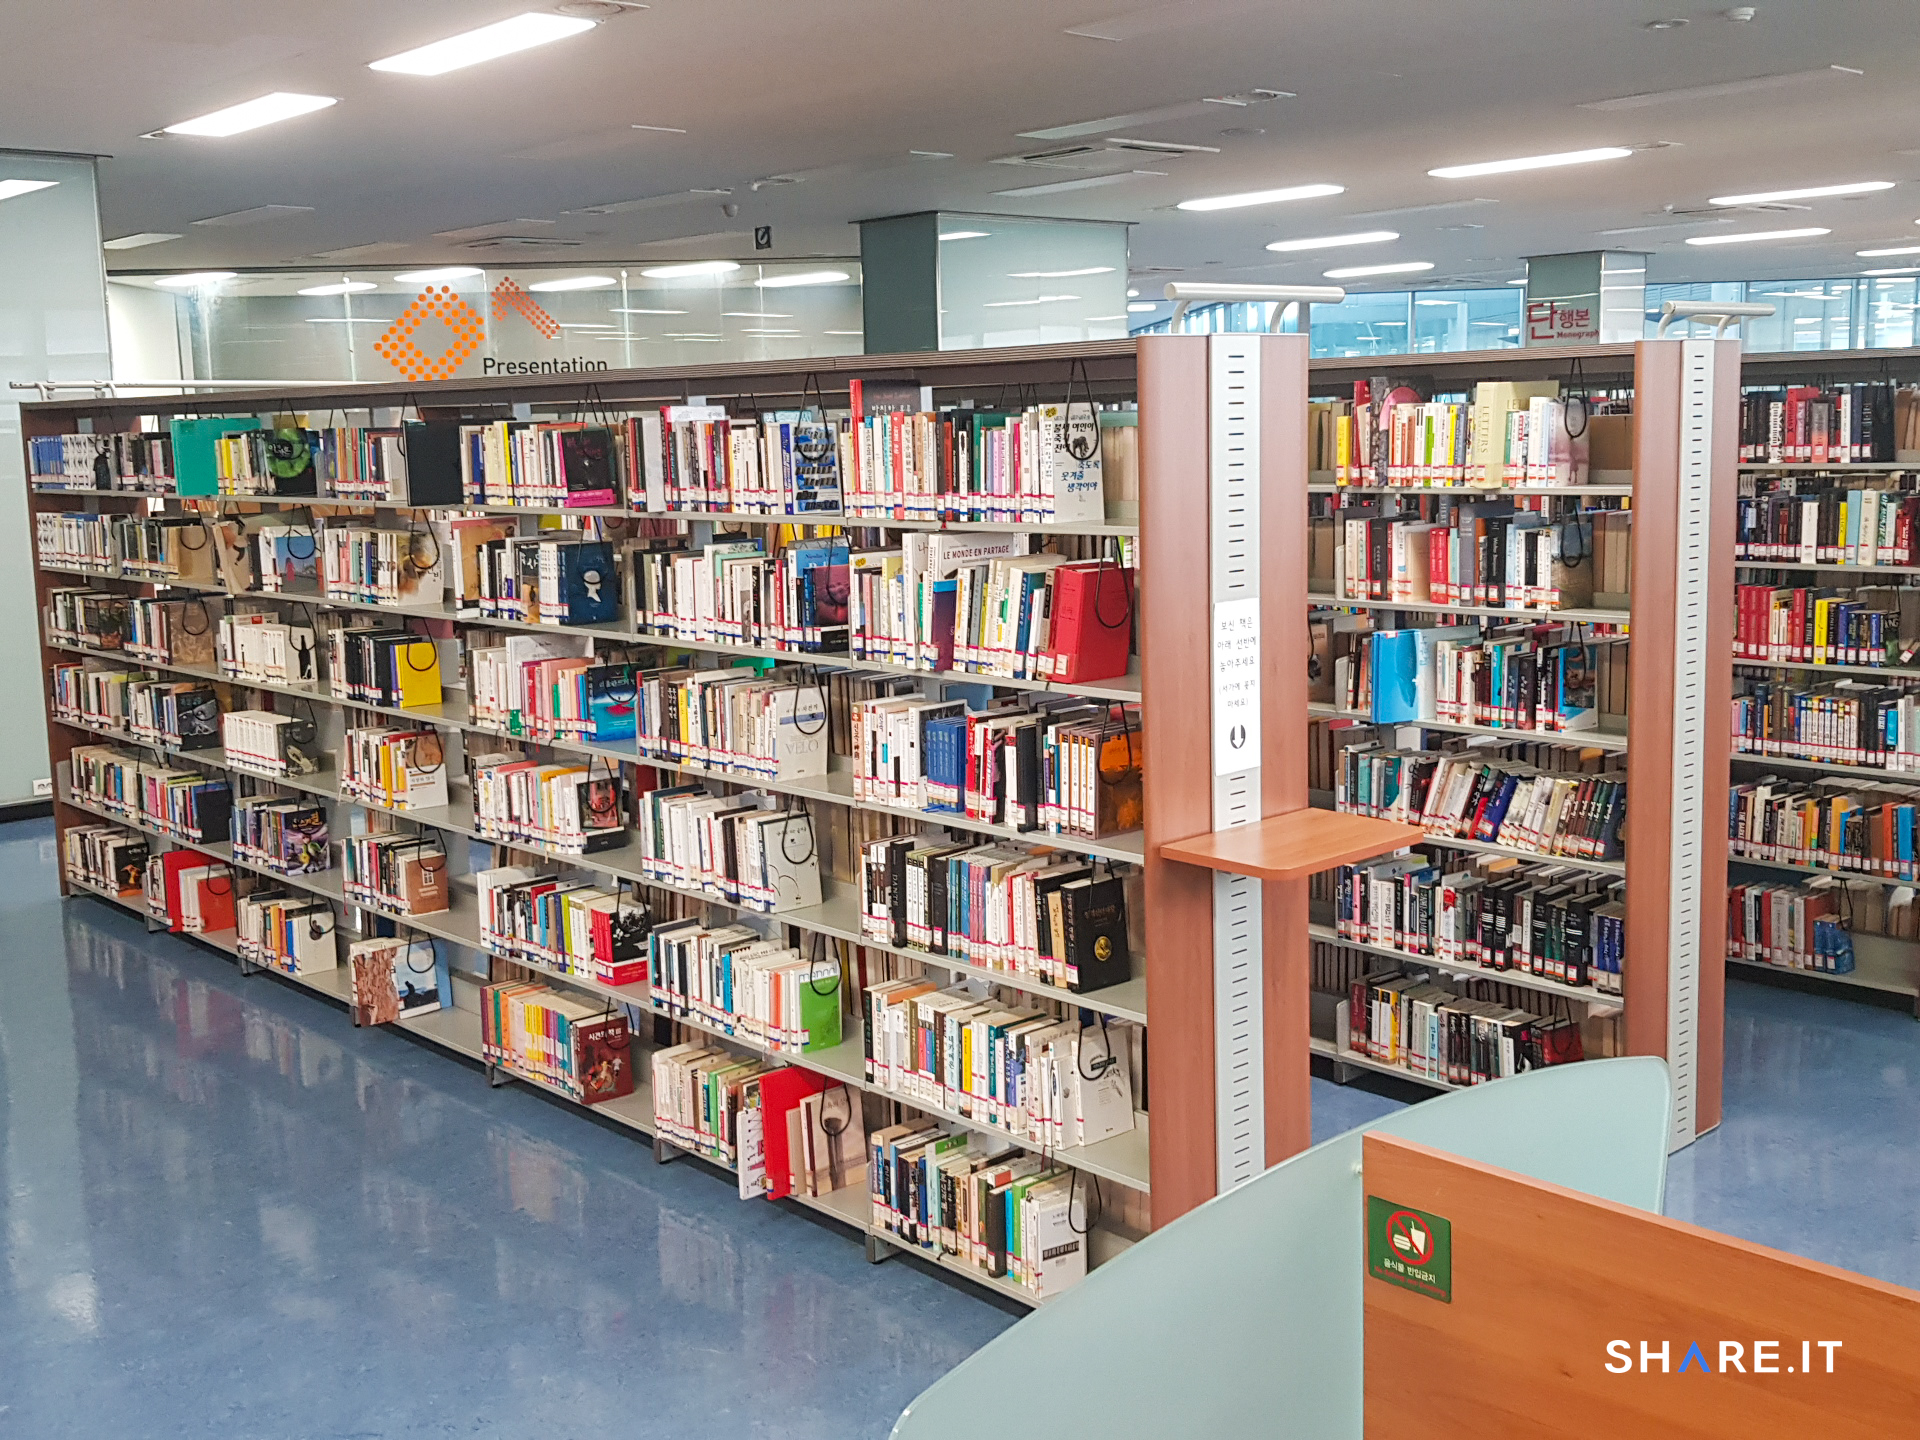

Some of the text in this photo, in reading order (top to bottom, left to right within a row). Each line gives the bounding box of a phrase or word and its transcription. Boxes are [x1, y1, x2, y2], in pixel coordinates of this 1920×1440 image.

[1528, 301, 1590, 339] 단행본
[1557, 329, 1599, 339] Monograph
[483, 357, 607, 374] Presentation
[1480, 406, 1489, 453] LETTERS
[1067, 481, 1098, 493] 생각이야
[943, 545, 1010, 560] LE MONDE EN PARTAGE
[1221, 616, 1253, 632] 보신 책은
[1217, 636, 1257, 650] 아래 선반에
[785, 740, 819, 754] VELO
[891, 874, 899, 907] DANTE
[1383, 1258, 1436, 1284] 음식물 반입금지
